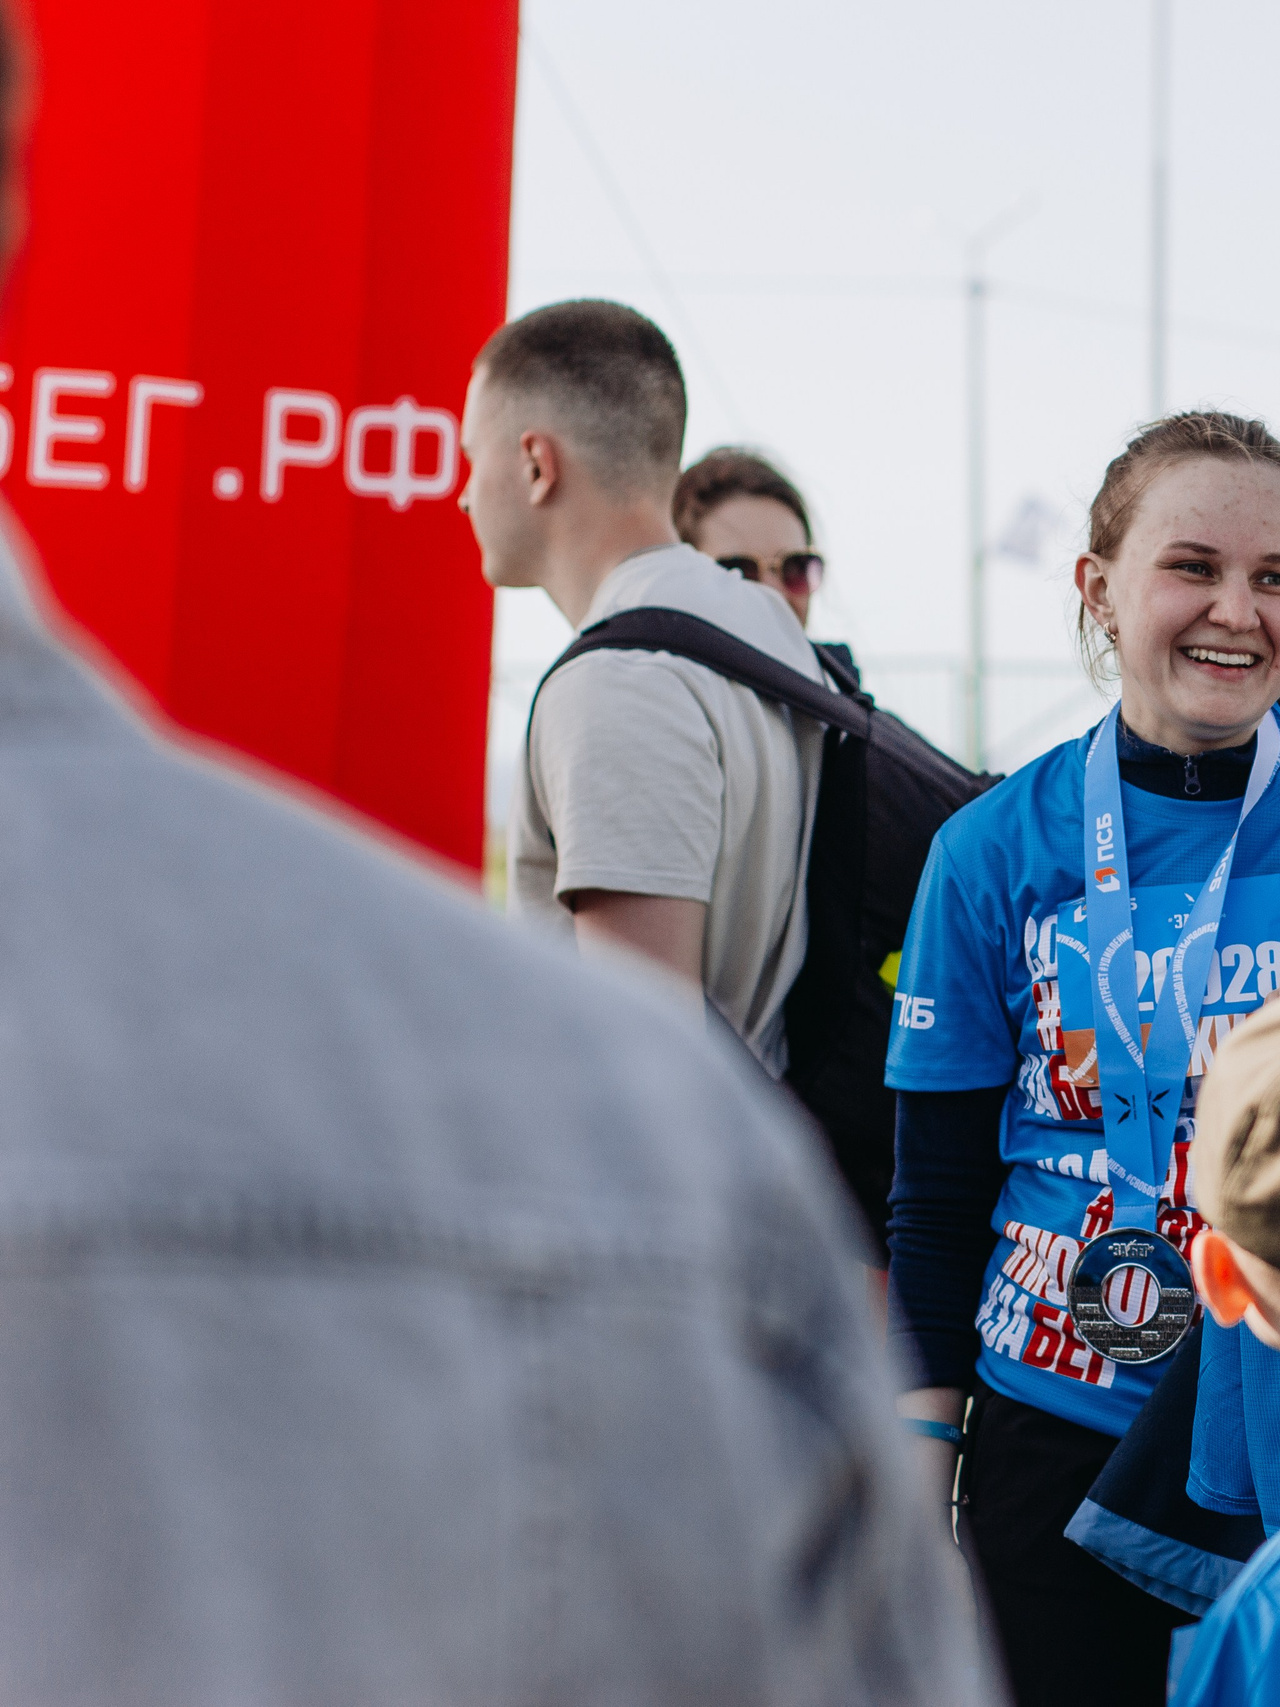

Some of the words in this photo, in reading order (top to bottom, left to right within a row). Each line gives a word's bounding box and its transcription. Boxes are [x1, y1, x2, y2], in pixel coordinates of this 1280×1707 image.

[0, 364, 458, 511] ЕГ.РФ
[1096, 812, 1115, 862] ПСБ
[1098, 928, 1133, 972] #УДИВЛЕНИЕ
[1097, 972, 1113, 1004] #ТРЕПЕТ
[1172, 973, 1188, 1014] #ГОРДОСТЬ
[1105, 1002, 1133, 1043] #ВОЛНЕНИЕ
[1125, 1173, 1157, 1198] #СВОБОД
